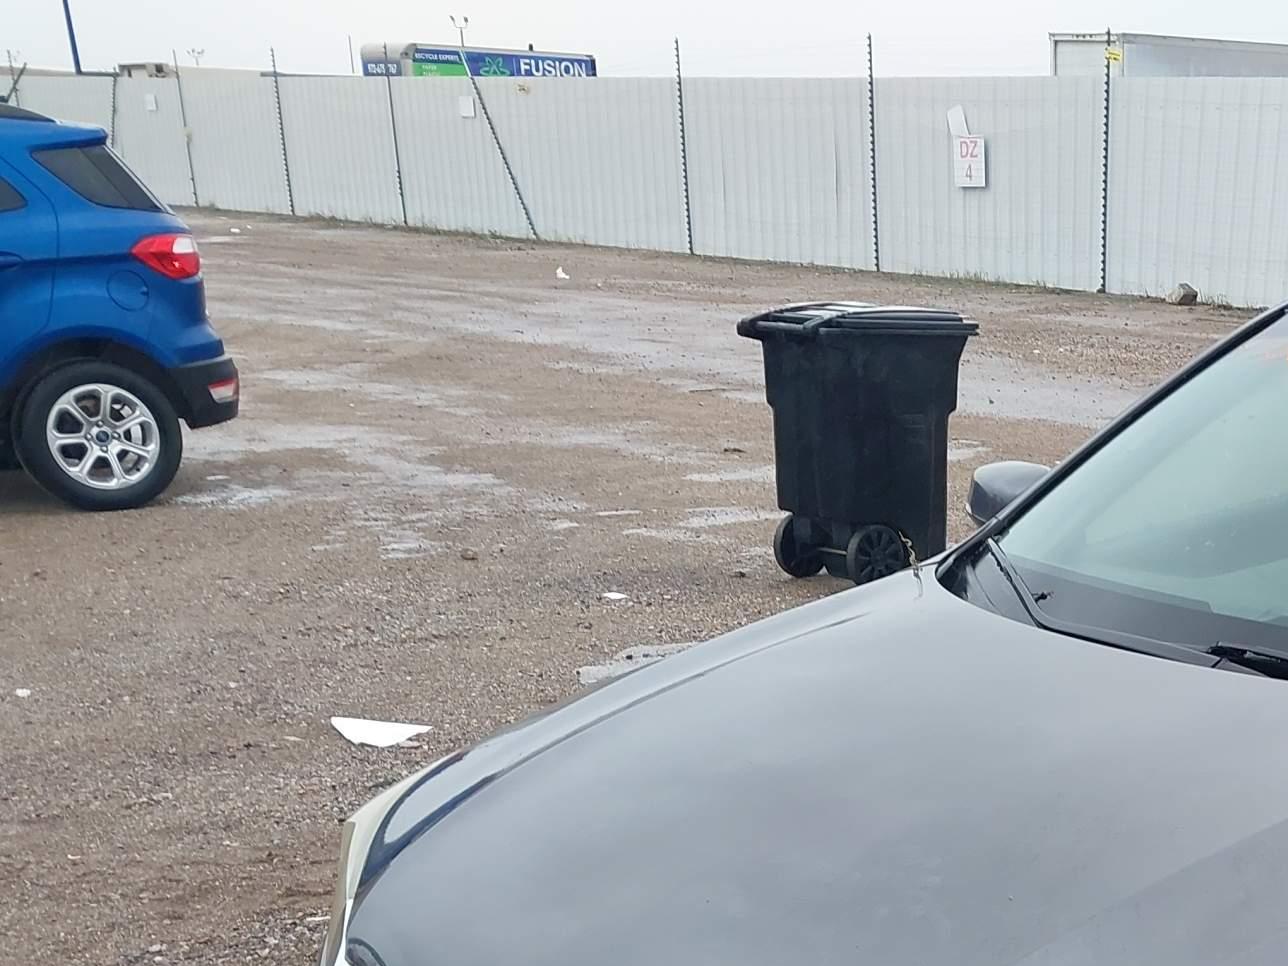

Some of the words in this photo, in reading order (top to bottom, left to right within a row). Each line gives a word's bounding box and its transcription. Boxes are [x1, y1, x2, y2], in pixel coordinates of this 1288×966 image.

[519, 58, 586, 77] FUSION
[960, 140, 978, 159] DZ
[965, 163, 973, 181] 4
